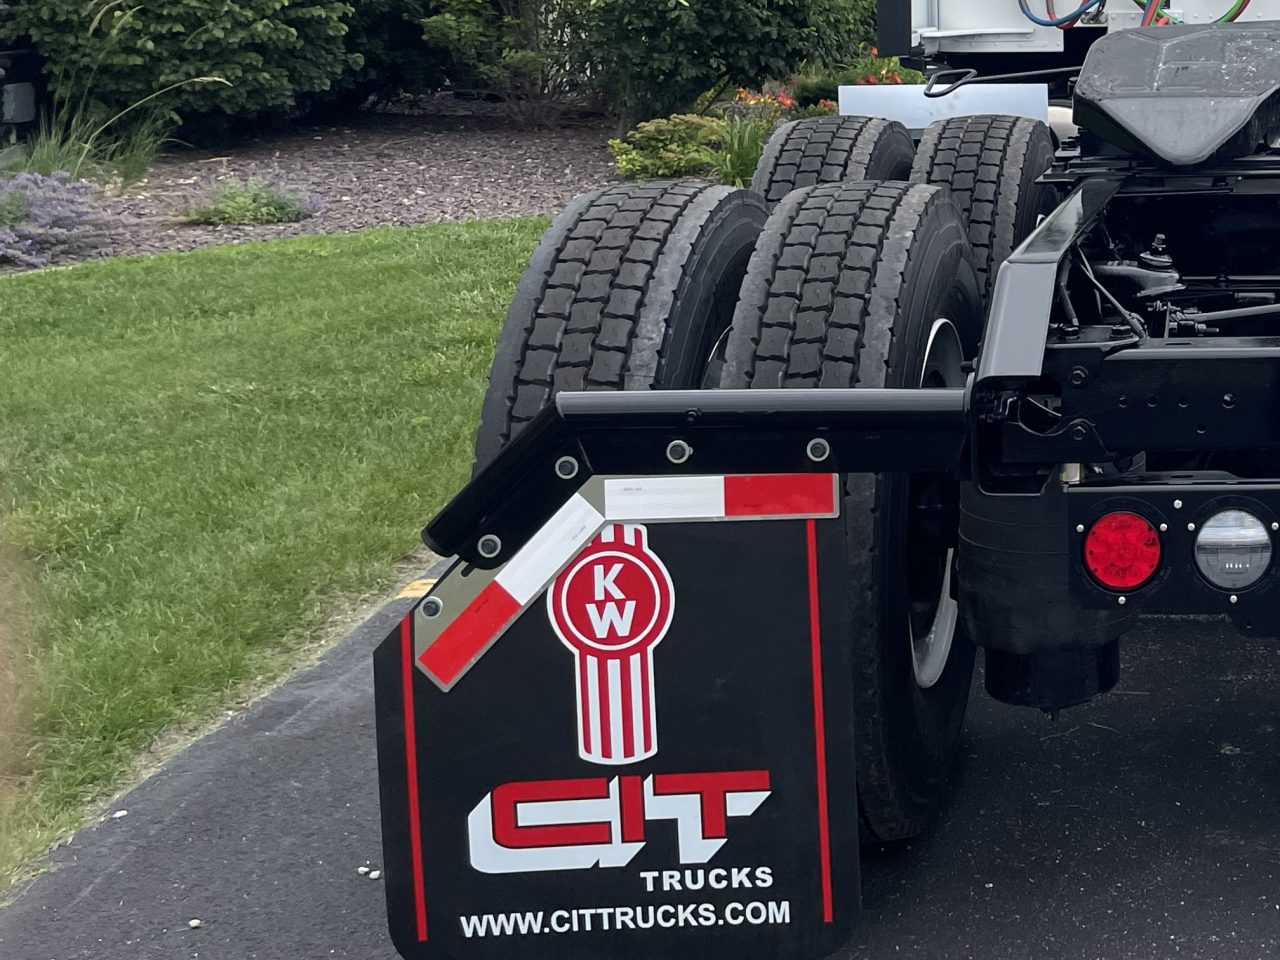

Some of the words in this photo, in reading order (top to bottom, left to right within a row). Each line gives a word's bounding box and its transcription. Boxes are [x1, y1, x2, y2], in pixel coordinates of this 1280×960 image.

[468, 770, 772, 874] CIT
[640, 866, 773, 892] TRUCKS
[460, 900, 791, 938] WWW.CITTRUCKS.COM
